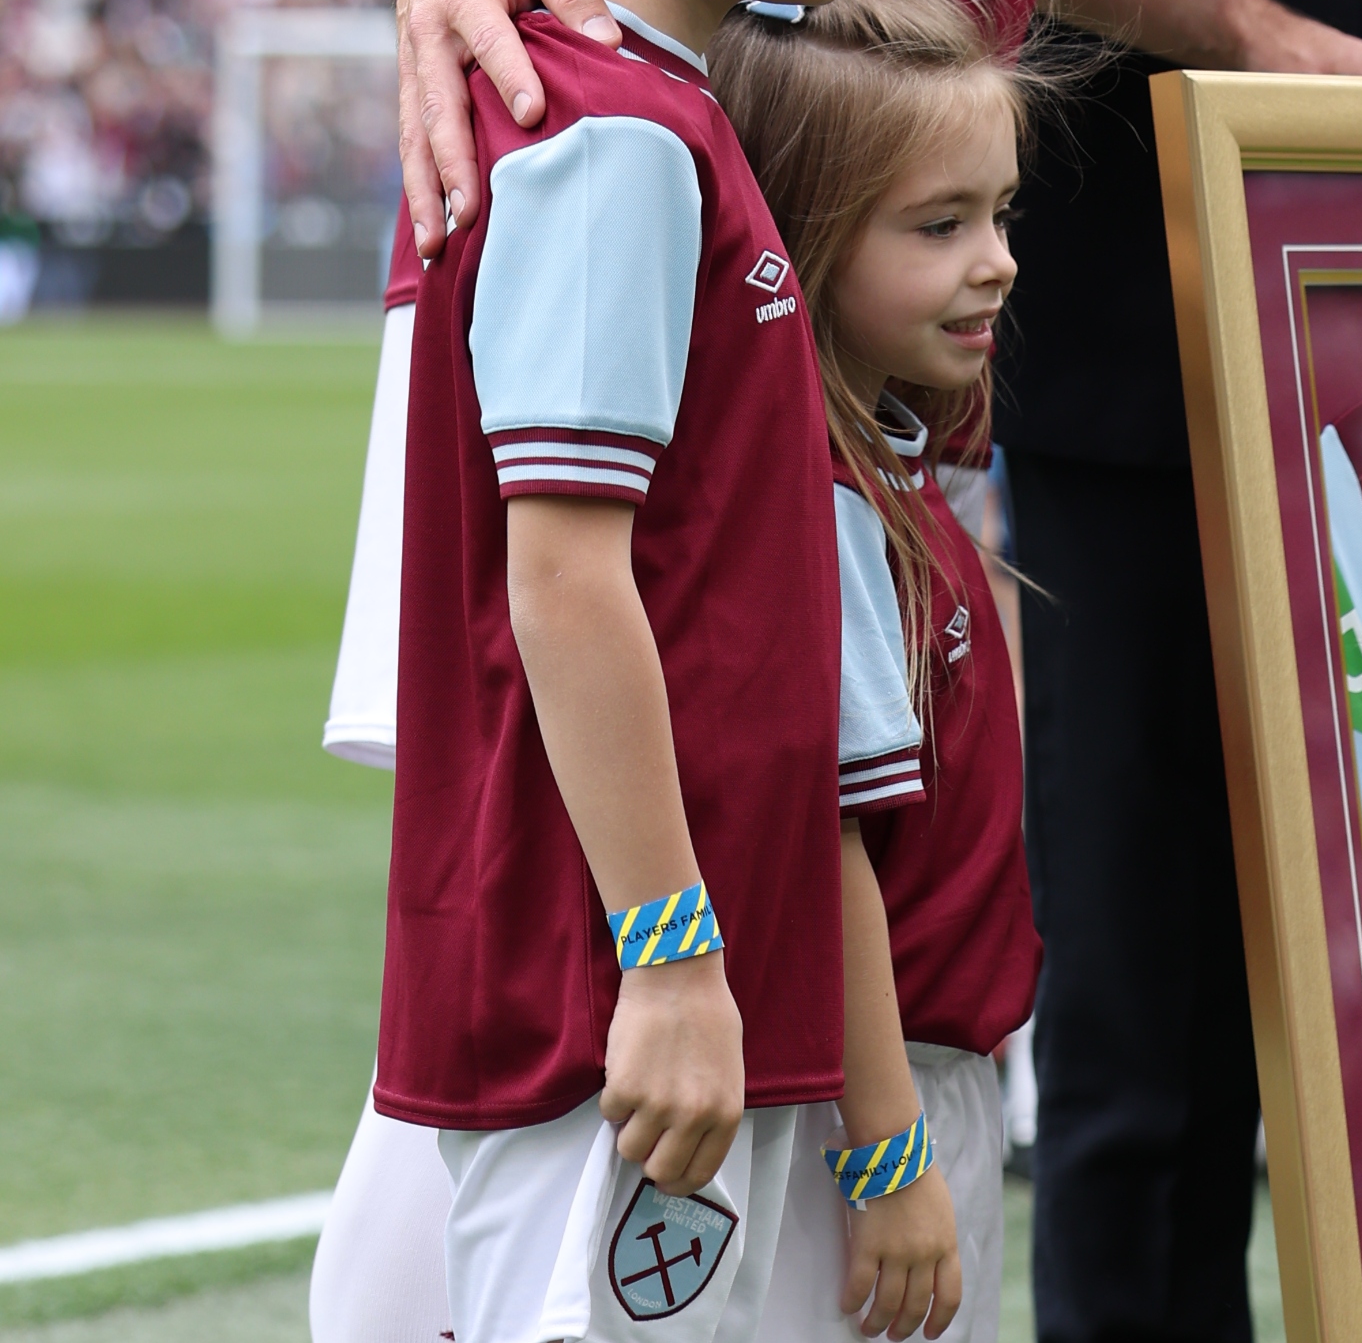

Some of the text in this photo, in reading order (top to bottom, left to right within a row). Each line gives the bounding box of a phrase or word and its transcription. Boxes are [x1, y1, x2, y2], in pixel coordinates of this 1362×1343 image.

[756, 296, 797, 324] umbro
[620, 919, 679, 946] PLAYERS
[844, 1162, 889, 1181] FAMILY
[652, 1190, 726, 1233] WEST HAM
[663, 1208, 707, 1234] UNITED
[627, 1288, 662, 1309] LONDON
